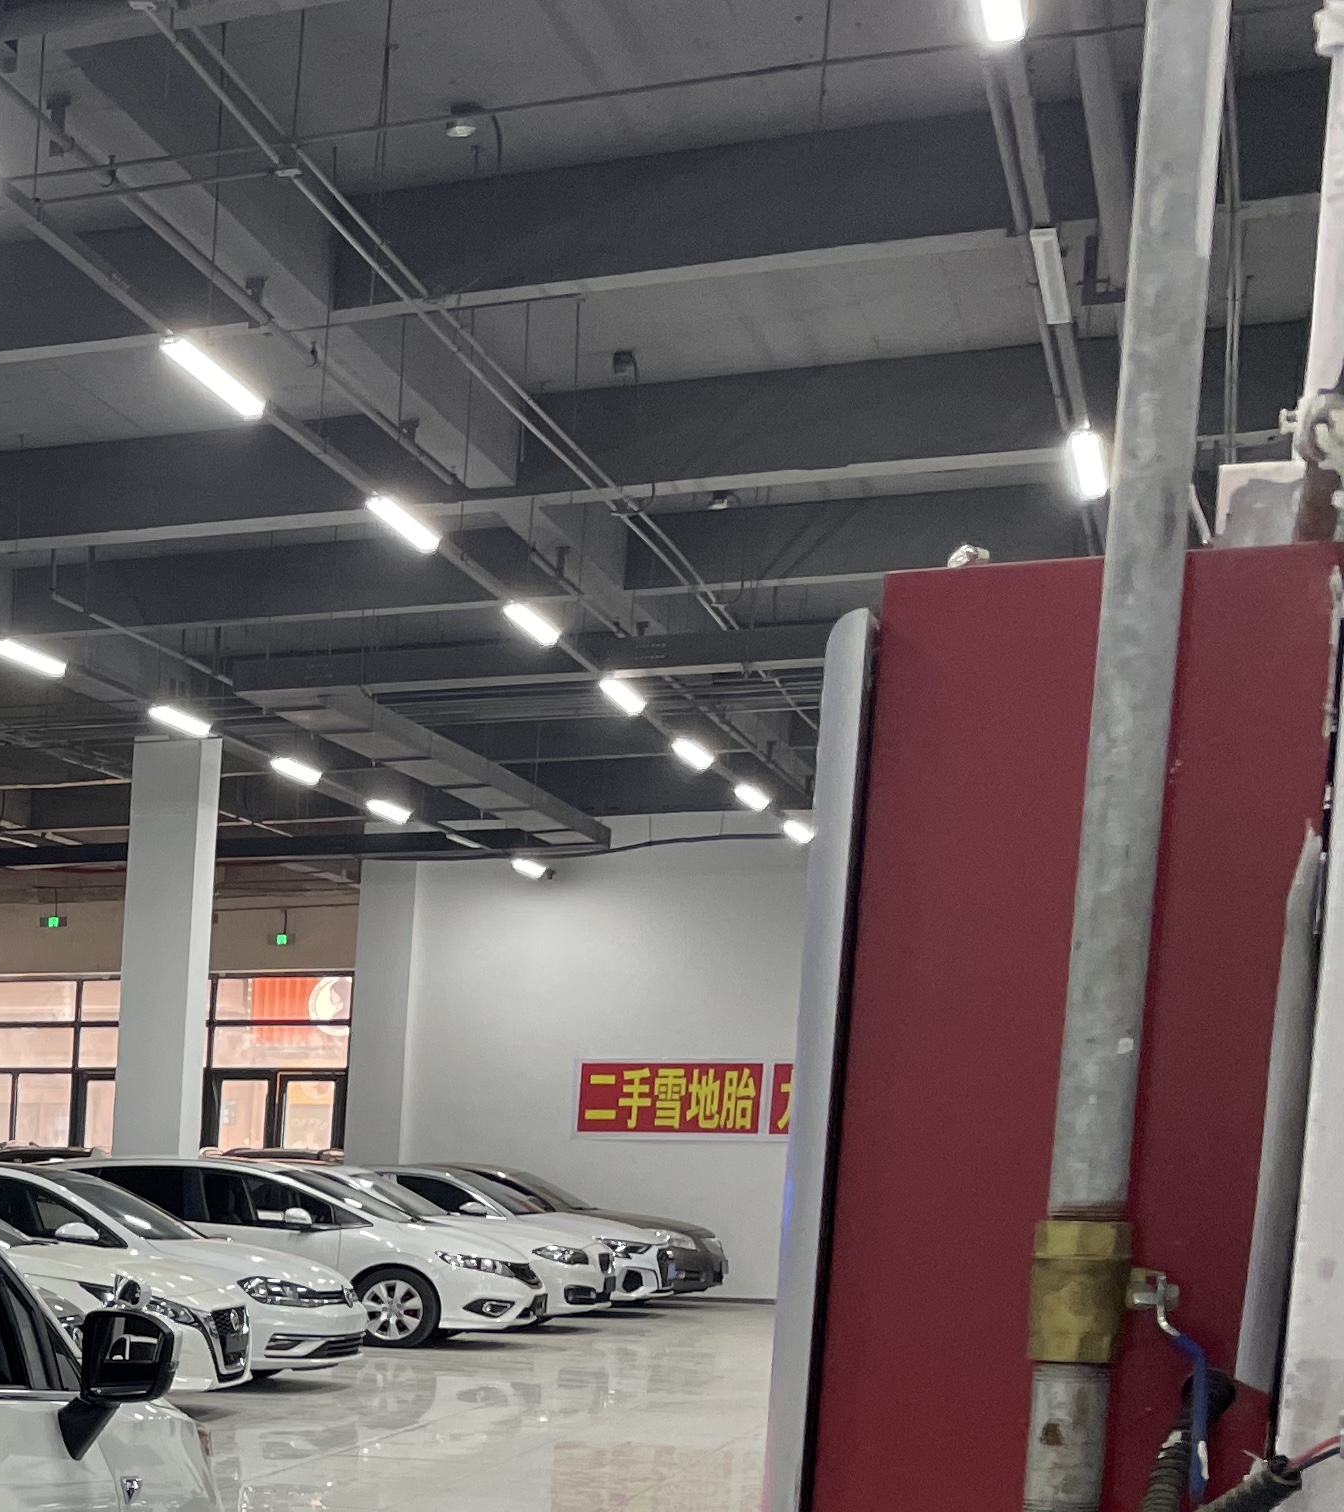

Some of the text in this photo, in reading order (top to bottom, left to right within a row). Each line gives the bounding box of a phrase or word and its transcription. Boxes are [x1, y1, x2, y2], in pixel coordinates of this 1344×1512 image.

[584, 1067, 756, 1130] 二手雪地胎
